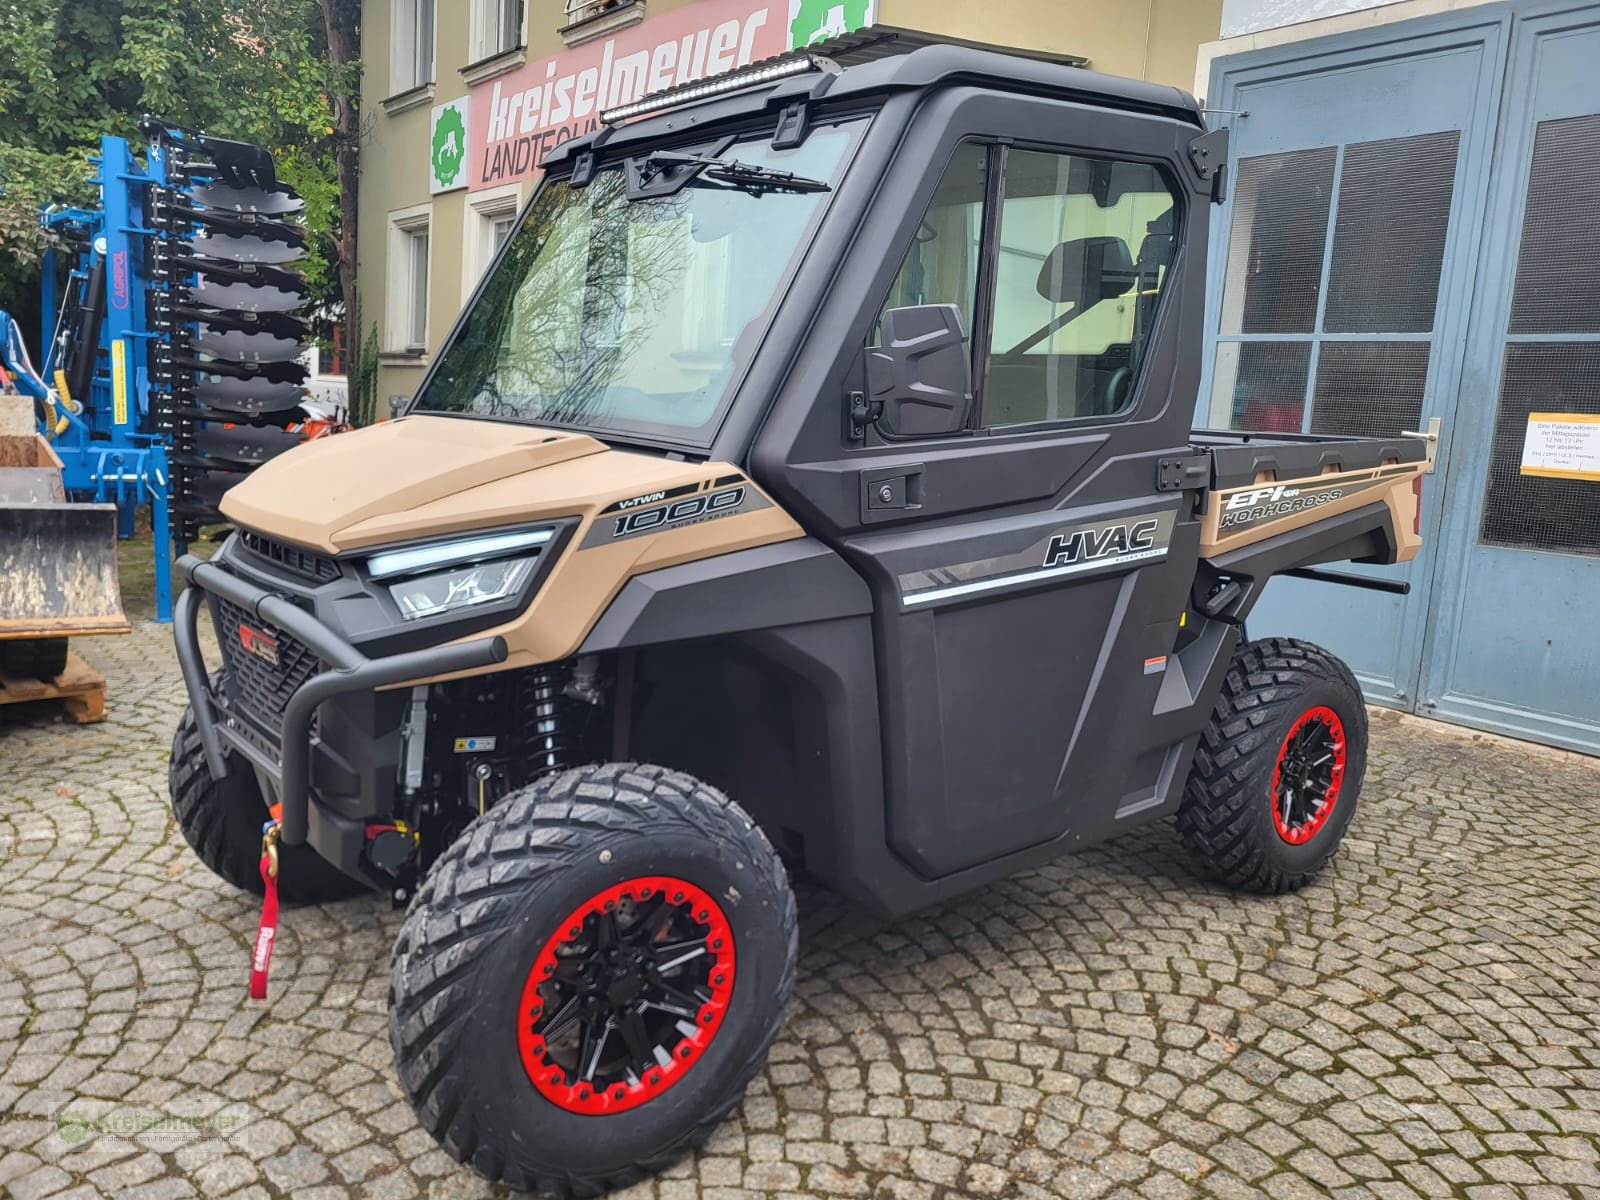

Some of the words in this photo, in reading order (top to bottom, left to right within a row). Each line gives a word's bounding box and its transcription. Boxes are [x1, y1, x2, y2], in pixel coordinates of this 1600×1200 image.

[612, 485, 747, 537] 1000
[619, 491, 666, 509] V-TWIN
[1225, 486, 1286, 510] EFI
[1042, 519, 1158, 567] HVAC
